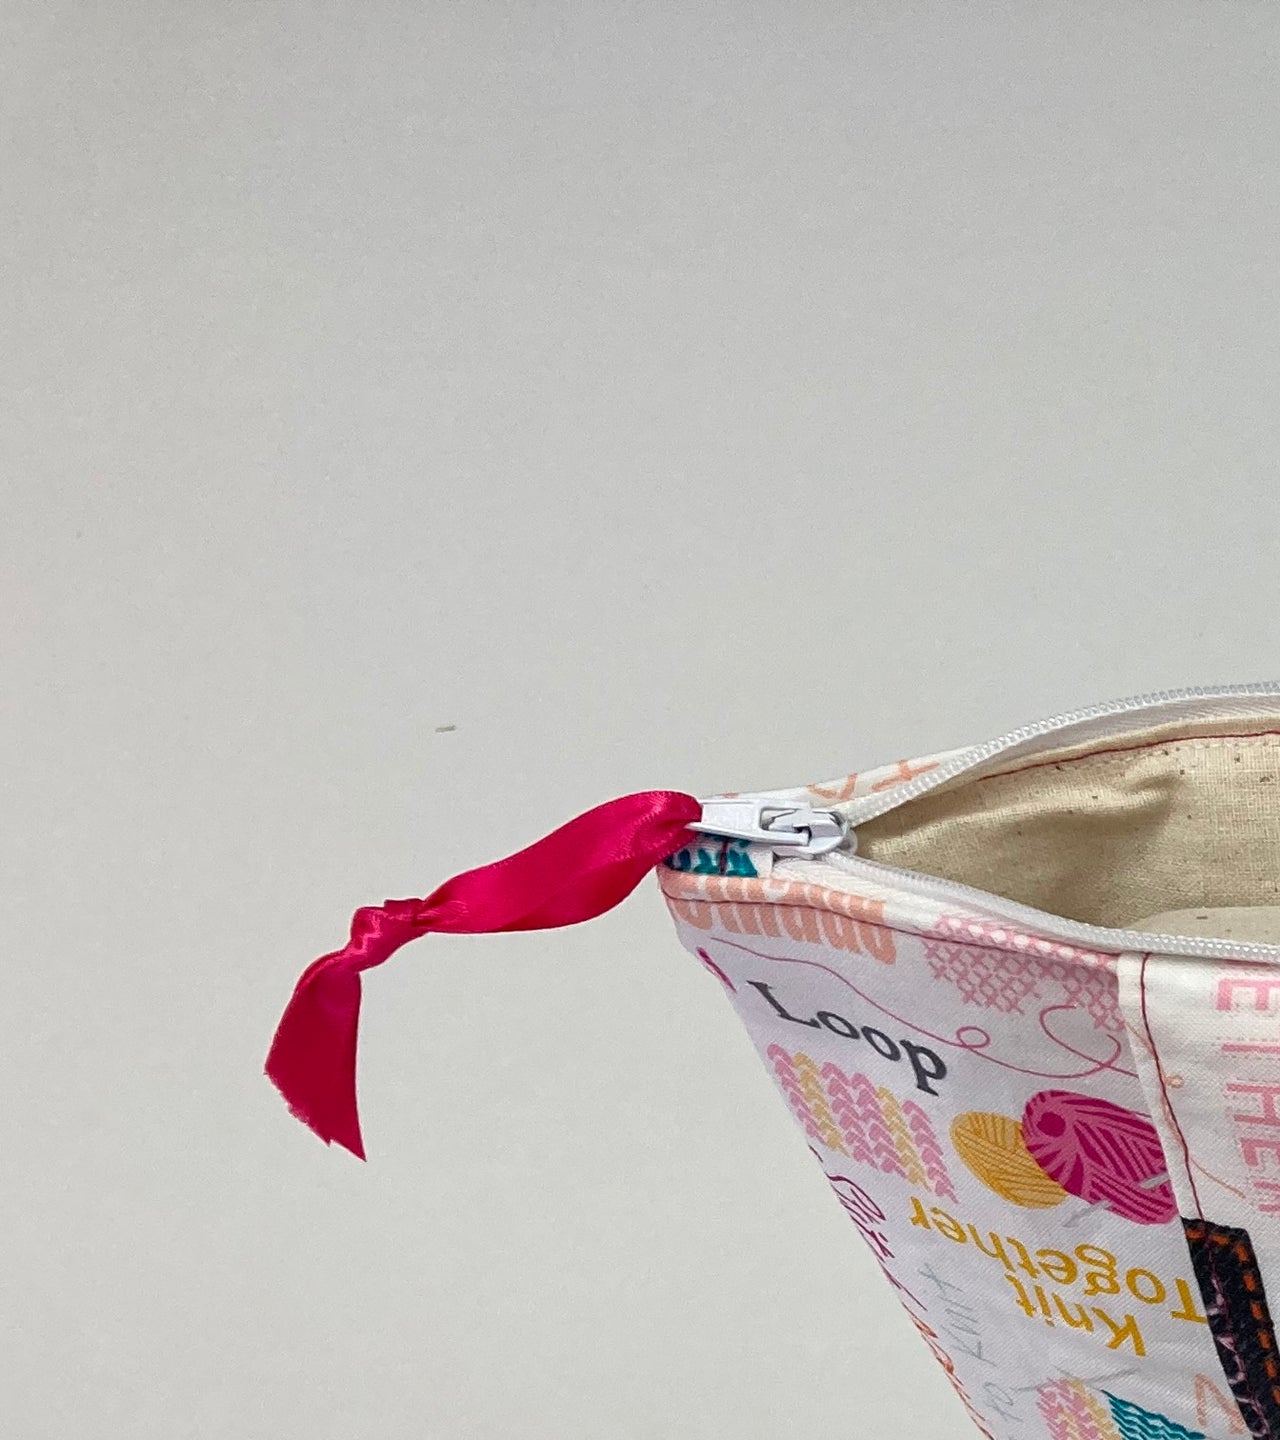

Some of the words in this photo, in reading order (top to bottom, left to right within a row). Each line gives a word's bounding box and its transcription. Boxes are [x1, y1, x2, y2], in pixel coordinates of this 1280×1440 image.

[747, 980, 948, 1096] Loop
[909, 1196, 1208, 1324] Together
[1005, 1273, 1147, 1358] Knit
